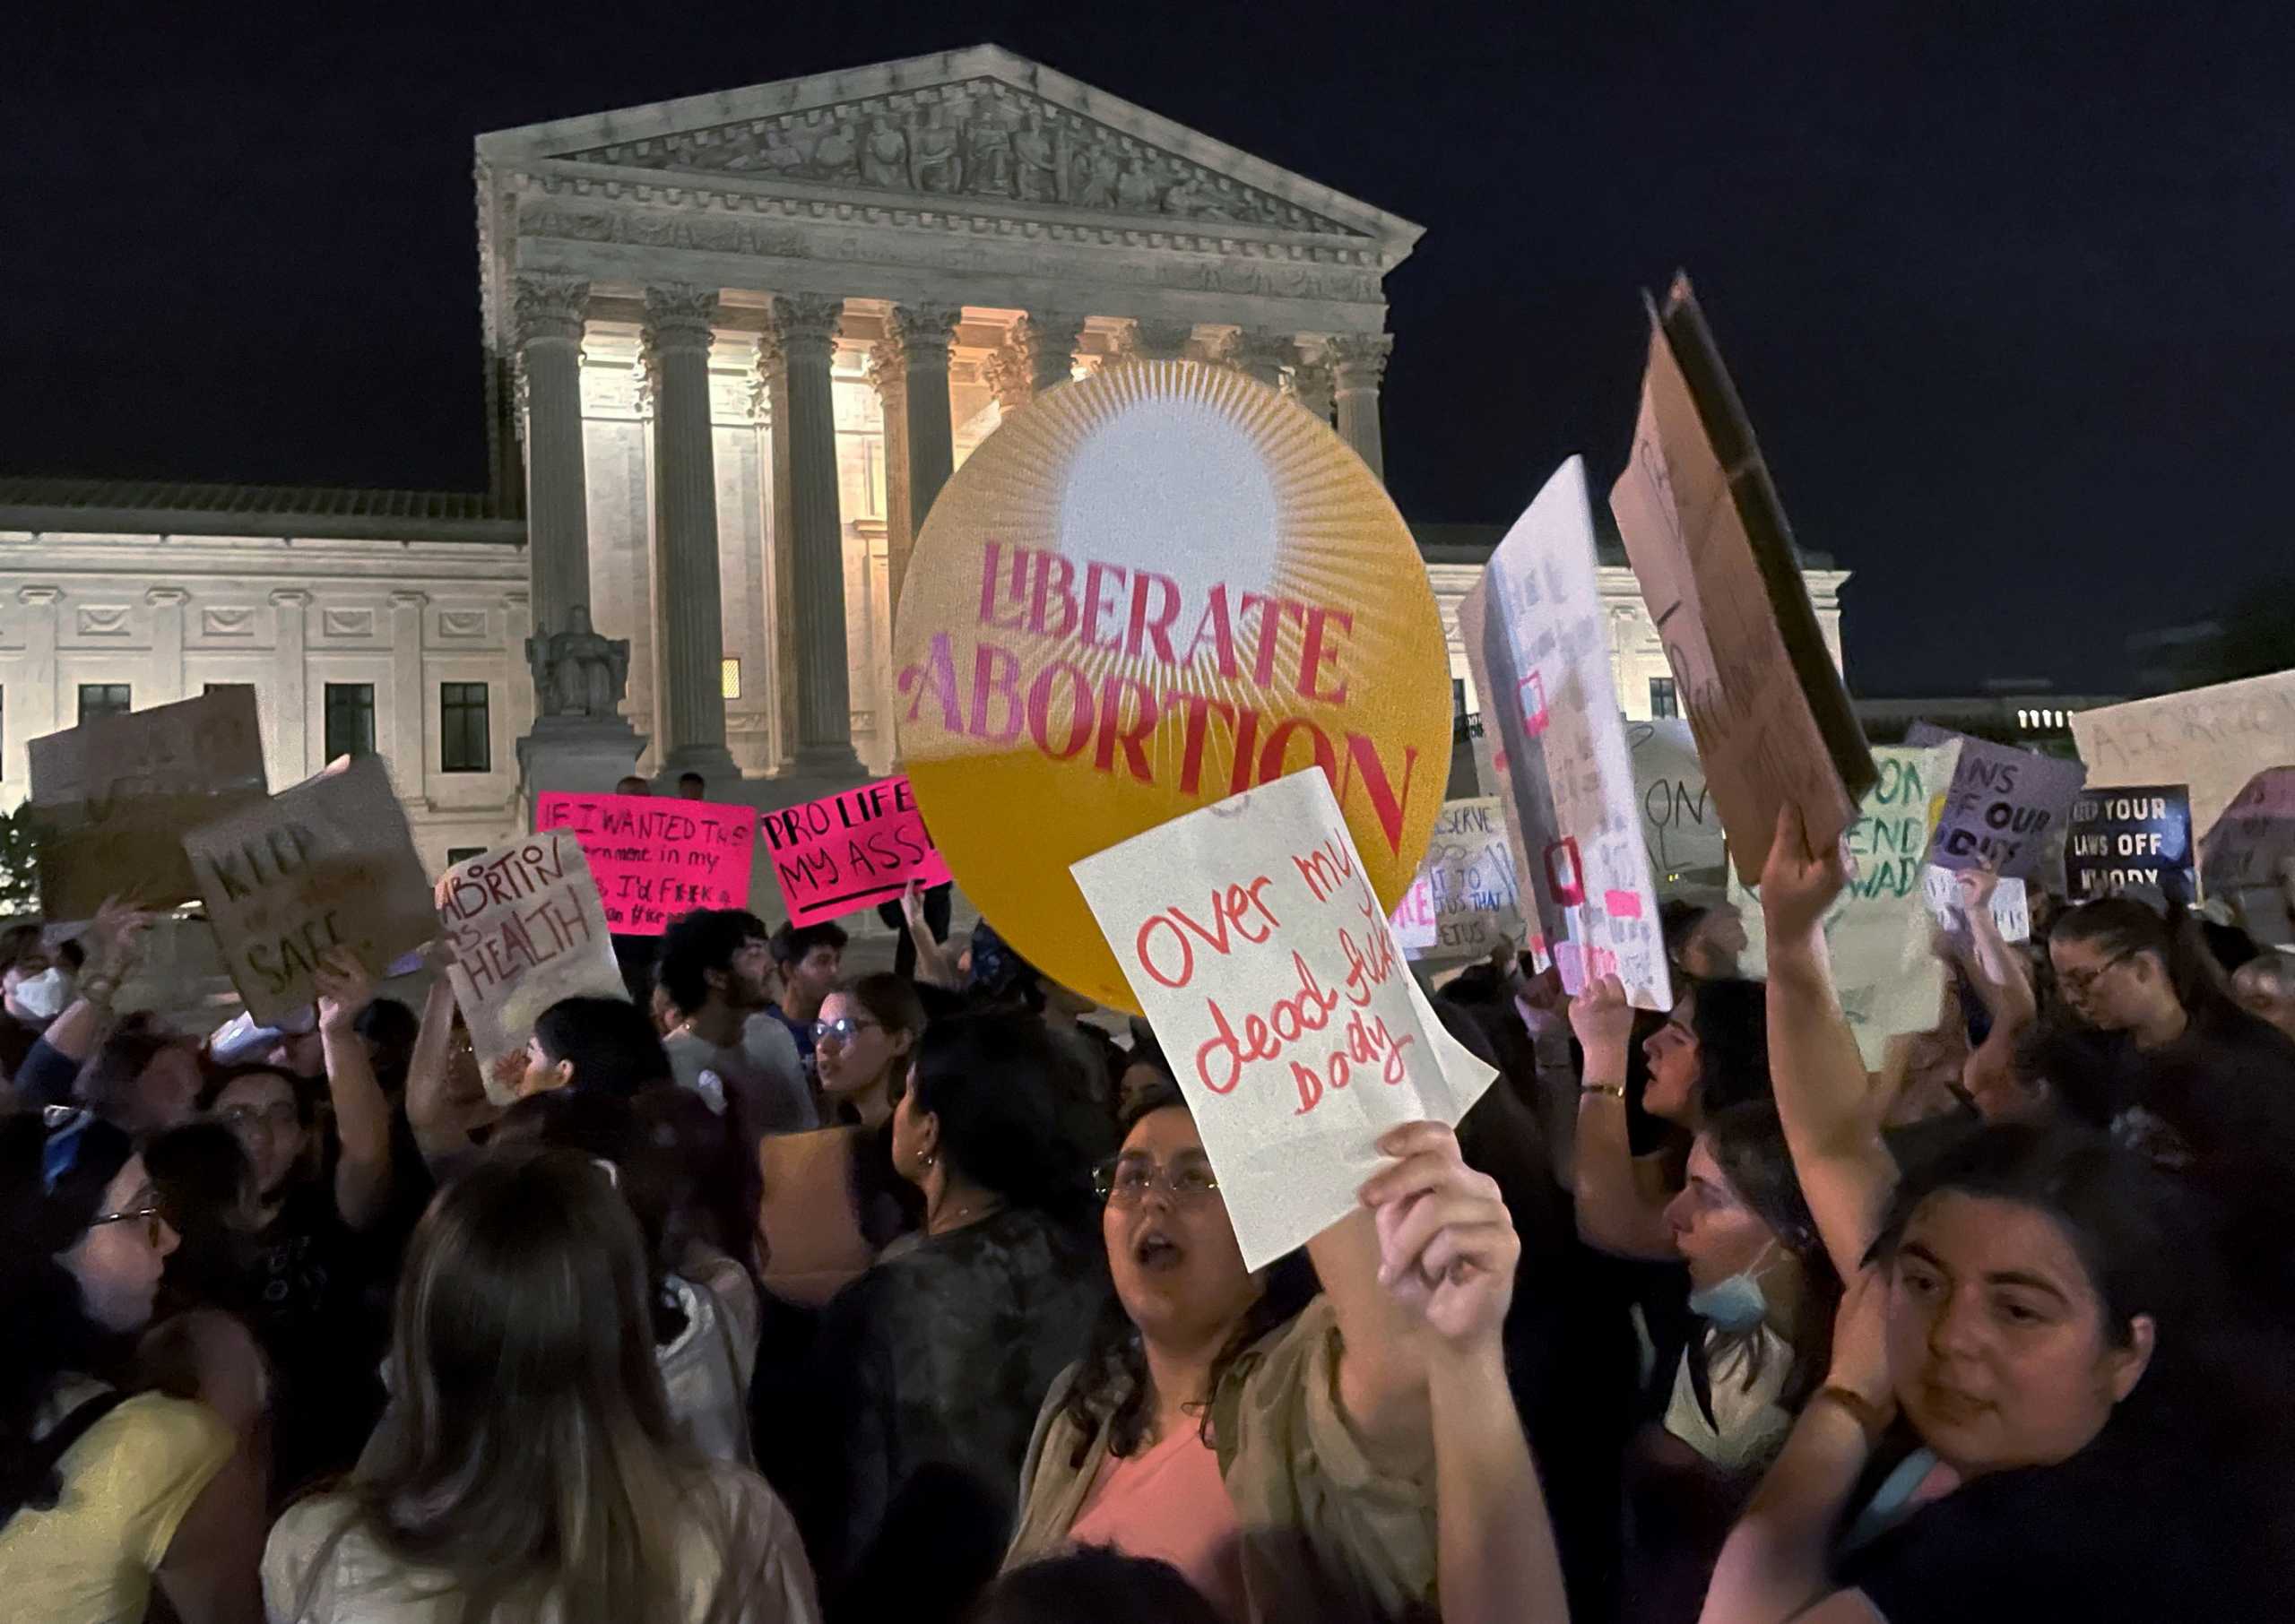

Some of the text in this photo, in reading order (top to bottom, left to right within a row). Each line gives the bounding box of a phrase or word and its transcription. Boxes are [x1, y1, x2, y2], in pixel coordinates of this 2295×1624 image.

[979, 543, 1355, 705] LIBERATE
[898, 631, 1419, 860] ABORTION
[1956, 757, 2018, 794] NS
[544, 802, 570, 826] IF
[575, 803, 597, 834] I
[602, 809, 697, 842] WANTED
[761, 781, 919, 851] PRO LIFE
[1435, 807, 1494, 836] SERVE
[2105, 798, 2166, 820] YOUR
[660, 847, 681, 866] in
[688, 851, 721, 875] my
[2074, 833, 2163, 857] LAWS OFF
[1849, 857, 1920, 899] WAD
[461, 884, 591, 1001] HEALTH
[1440, 920, 1486, 947] ETUS
[1195, 949, 1339, 1095] dead
